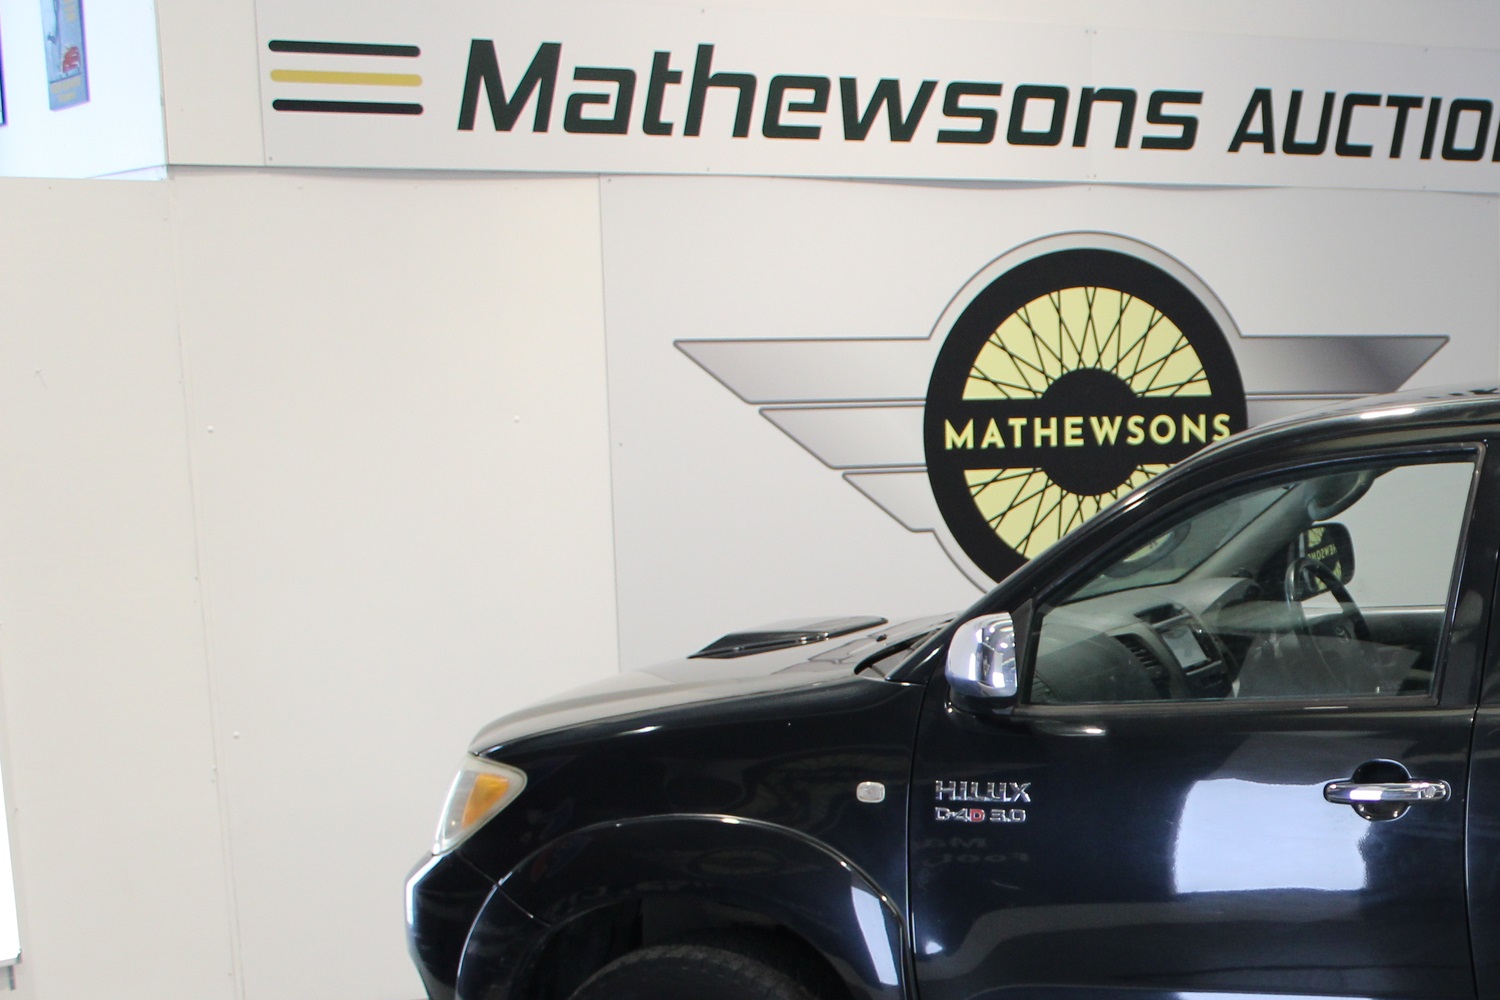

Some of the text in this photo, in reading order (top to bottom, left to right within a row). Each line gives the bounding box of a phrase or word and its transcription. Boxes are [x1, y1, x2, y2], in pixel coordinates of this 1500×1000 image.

[457, 39, 1203, 151] Mathewsons
[944, 413, 1231, 450] MATHEWSONS
[935, 780, 1031, 802] HILUX
[989, 808, 1026, 822] 3.0
